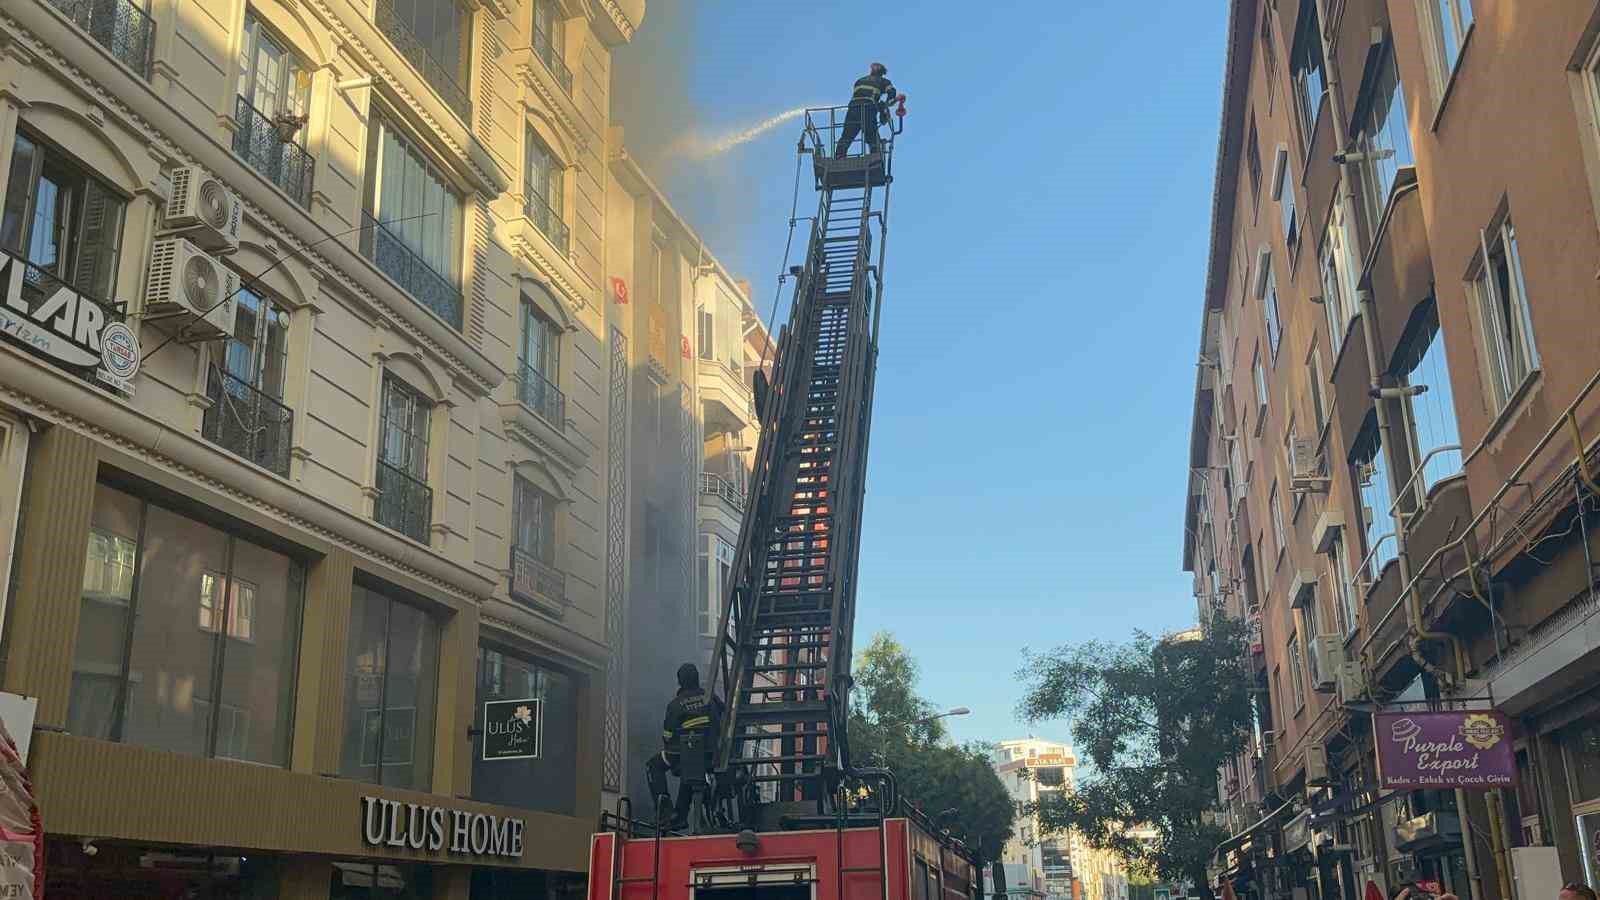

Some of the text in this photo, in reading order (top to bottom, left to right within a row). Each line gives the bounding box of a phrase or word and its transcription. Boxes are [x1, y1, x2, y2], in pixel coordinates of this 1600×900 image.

[0, 253, 104, 355] LAR
[1404, 734, 1464, 758] Purple
[1417, 752, 1480, 776] Export
[365, 796, 524, 857] ULUS HOME
